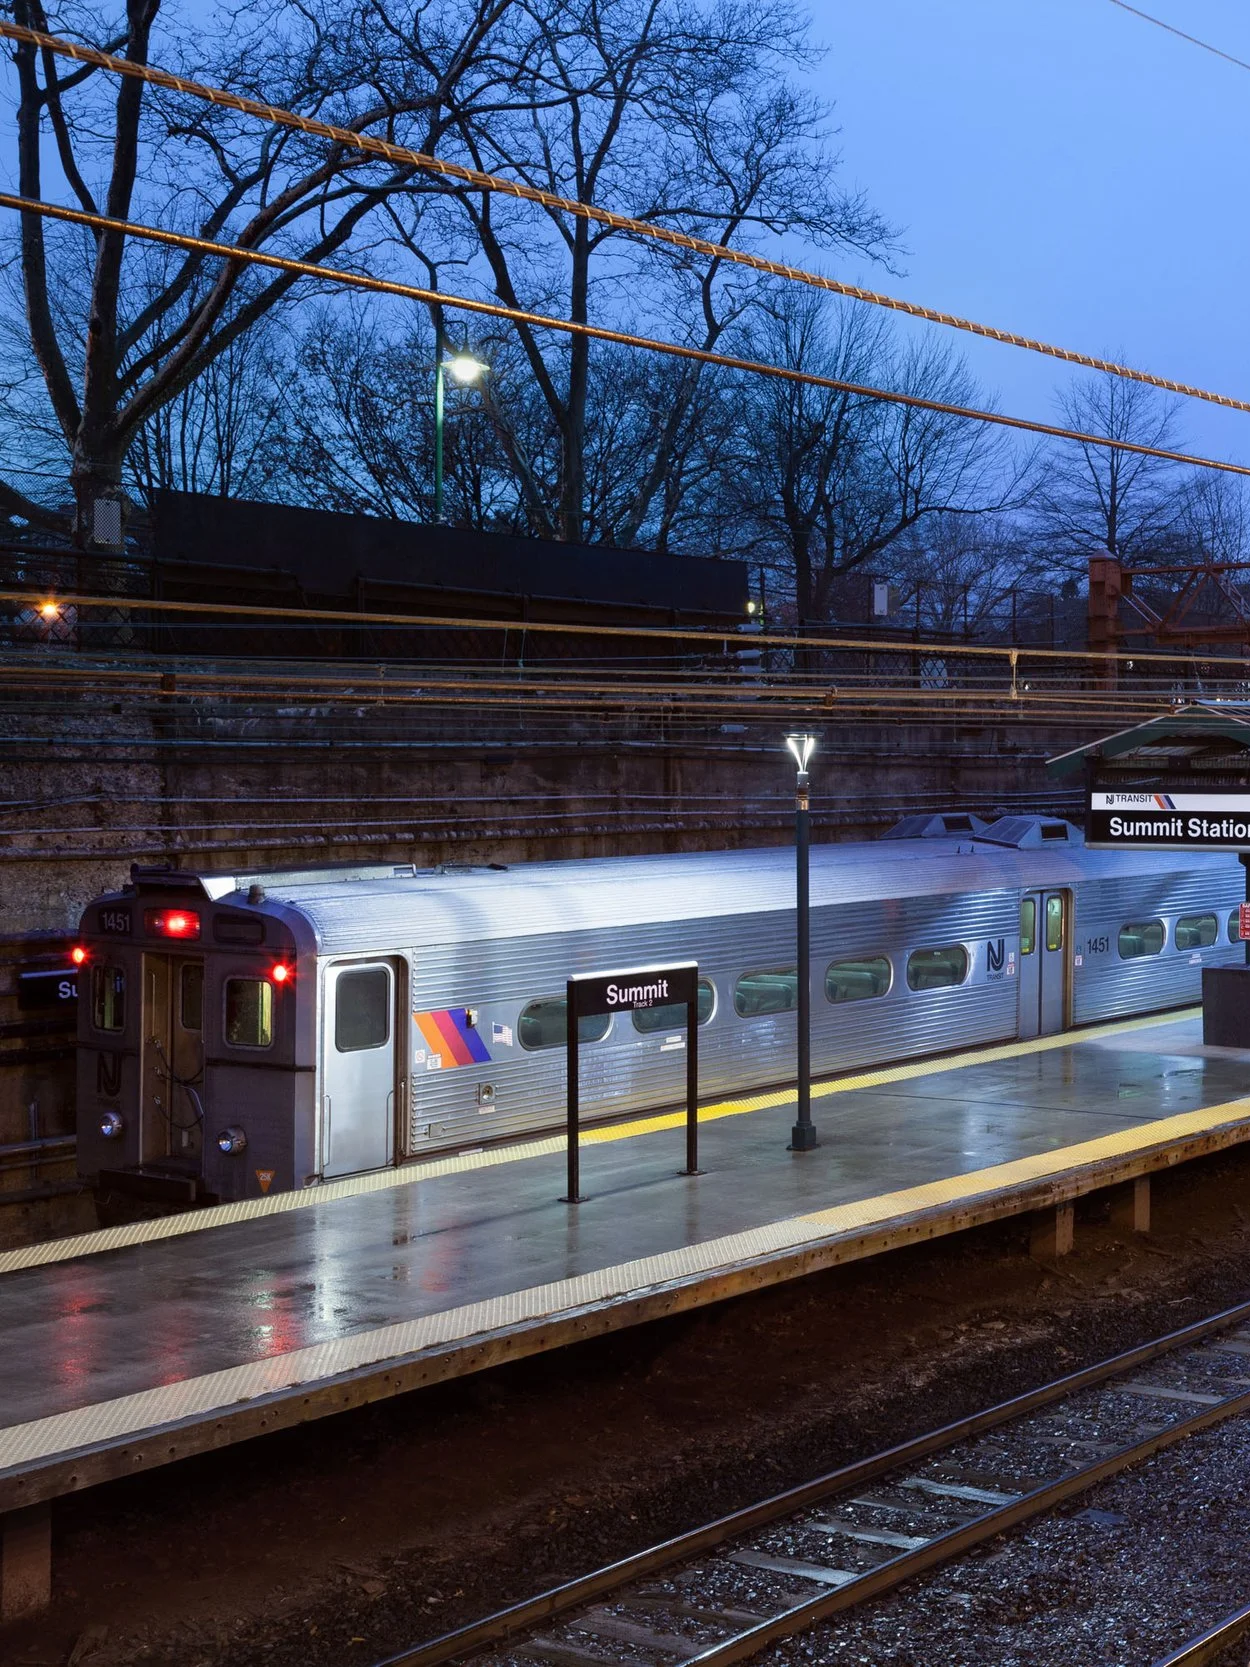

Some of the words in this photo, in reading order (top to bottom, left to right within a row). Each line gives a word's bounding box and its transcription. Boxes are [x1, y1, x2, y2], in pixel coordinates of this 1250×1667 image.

[1115, 794, 1153, 803] TRANSIT
[1109, 817, 1183, 836] Summit
[102, 911, 131, 932] 1451
[1087, 937, 1110, 954] 1451
[606, 979, 669, 1005] Summit
